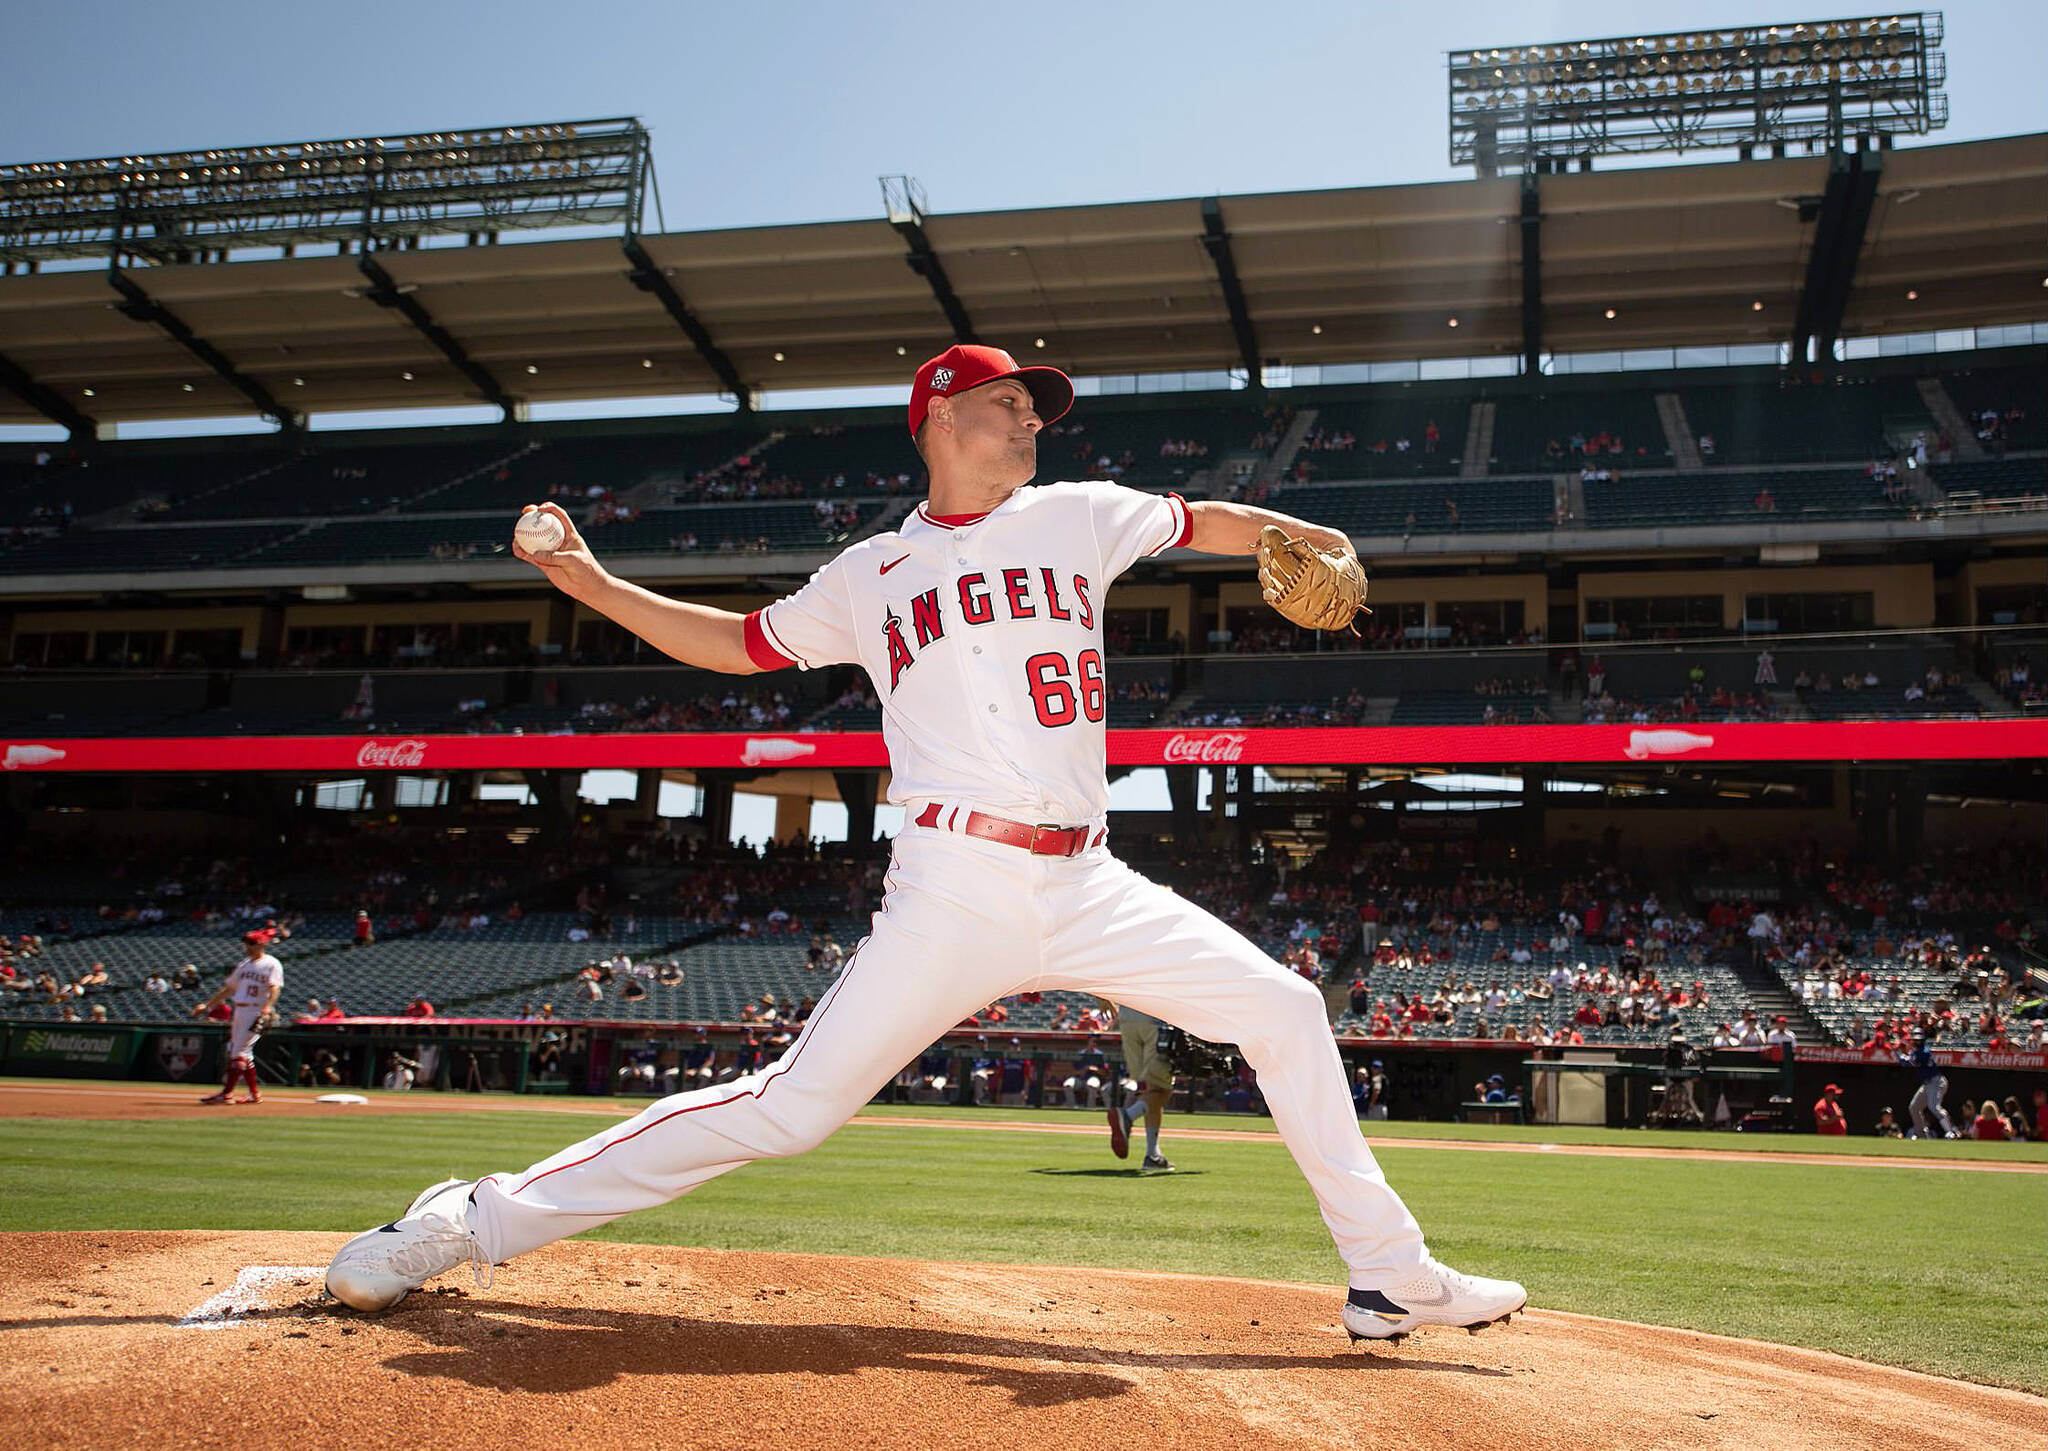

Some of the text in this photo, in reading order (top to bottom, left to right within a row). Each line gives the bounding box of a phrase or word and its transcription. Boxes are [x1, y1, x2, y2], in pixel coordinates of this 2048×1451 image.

[881, 567, 1095, 695] ANGELS
[1025, 648, 1105, 728] 66
[44, 1033, 115, 1053] National
[160, 1037, 200, 1049] MLB
